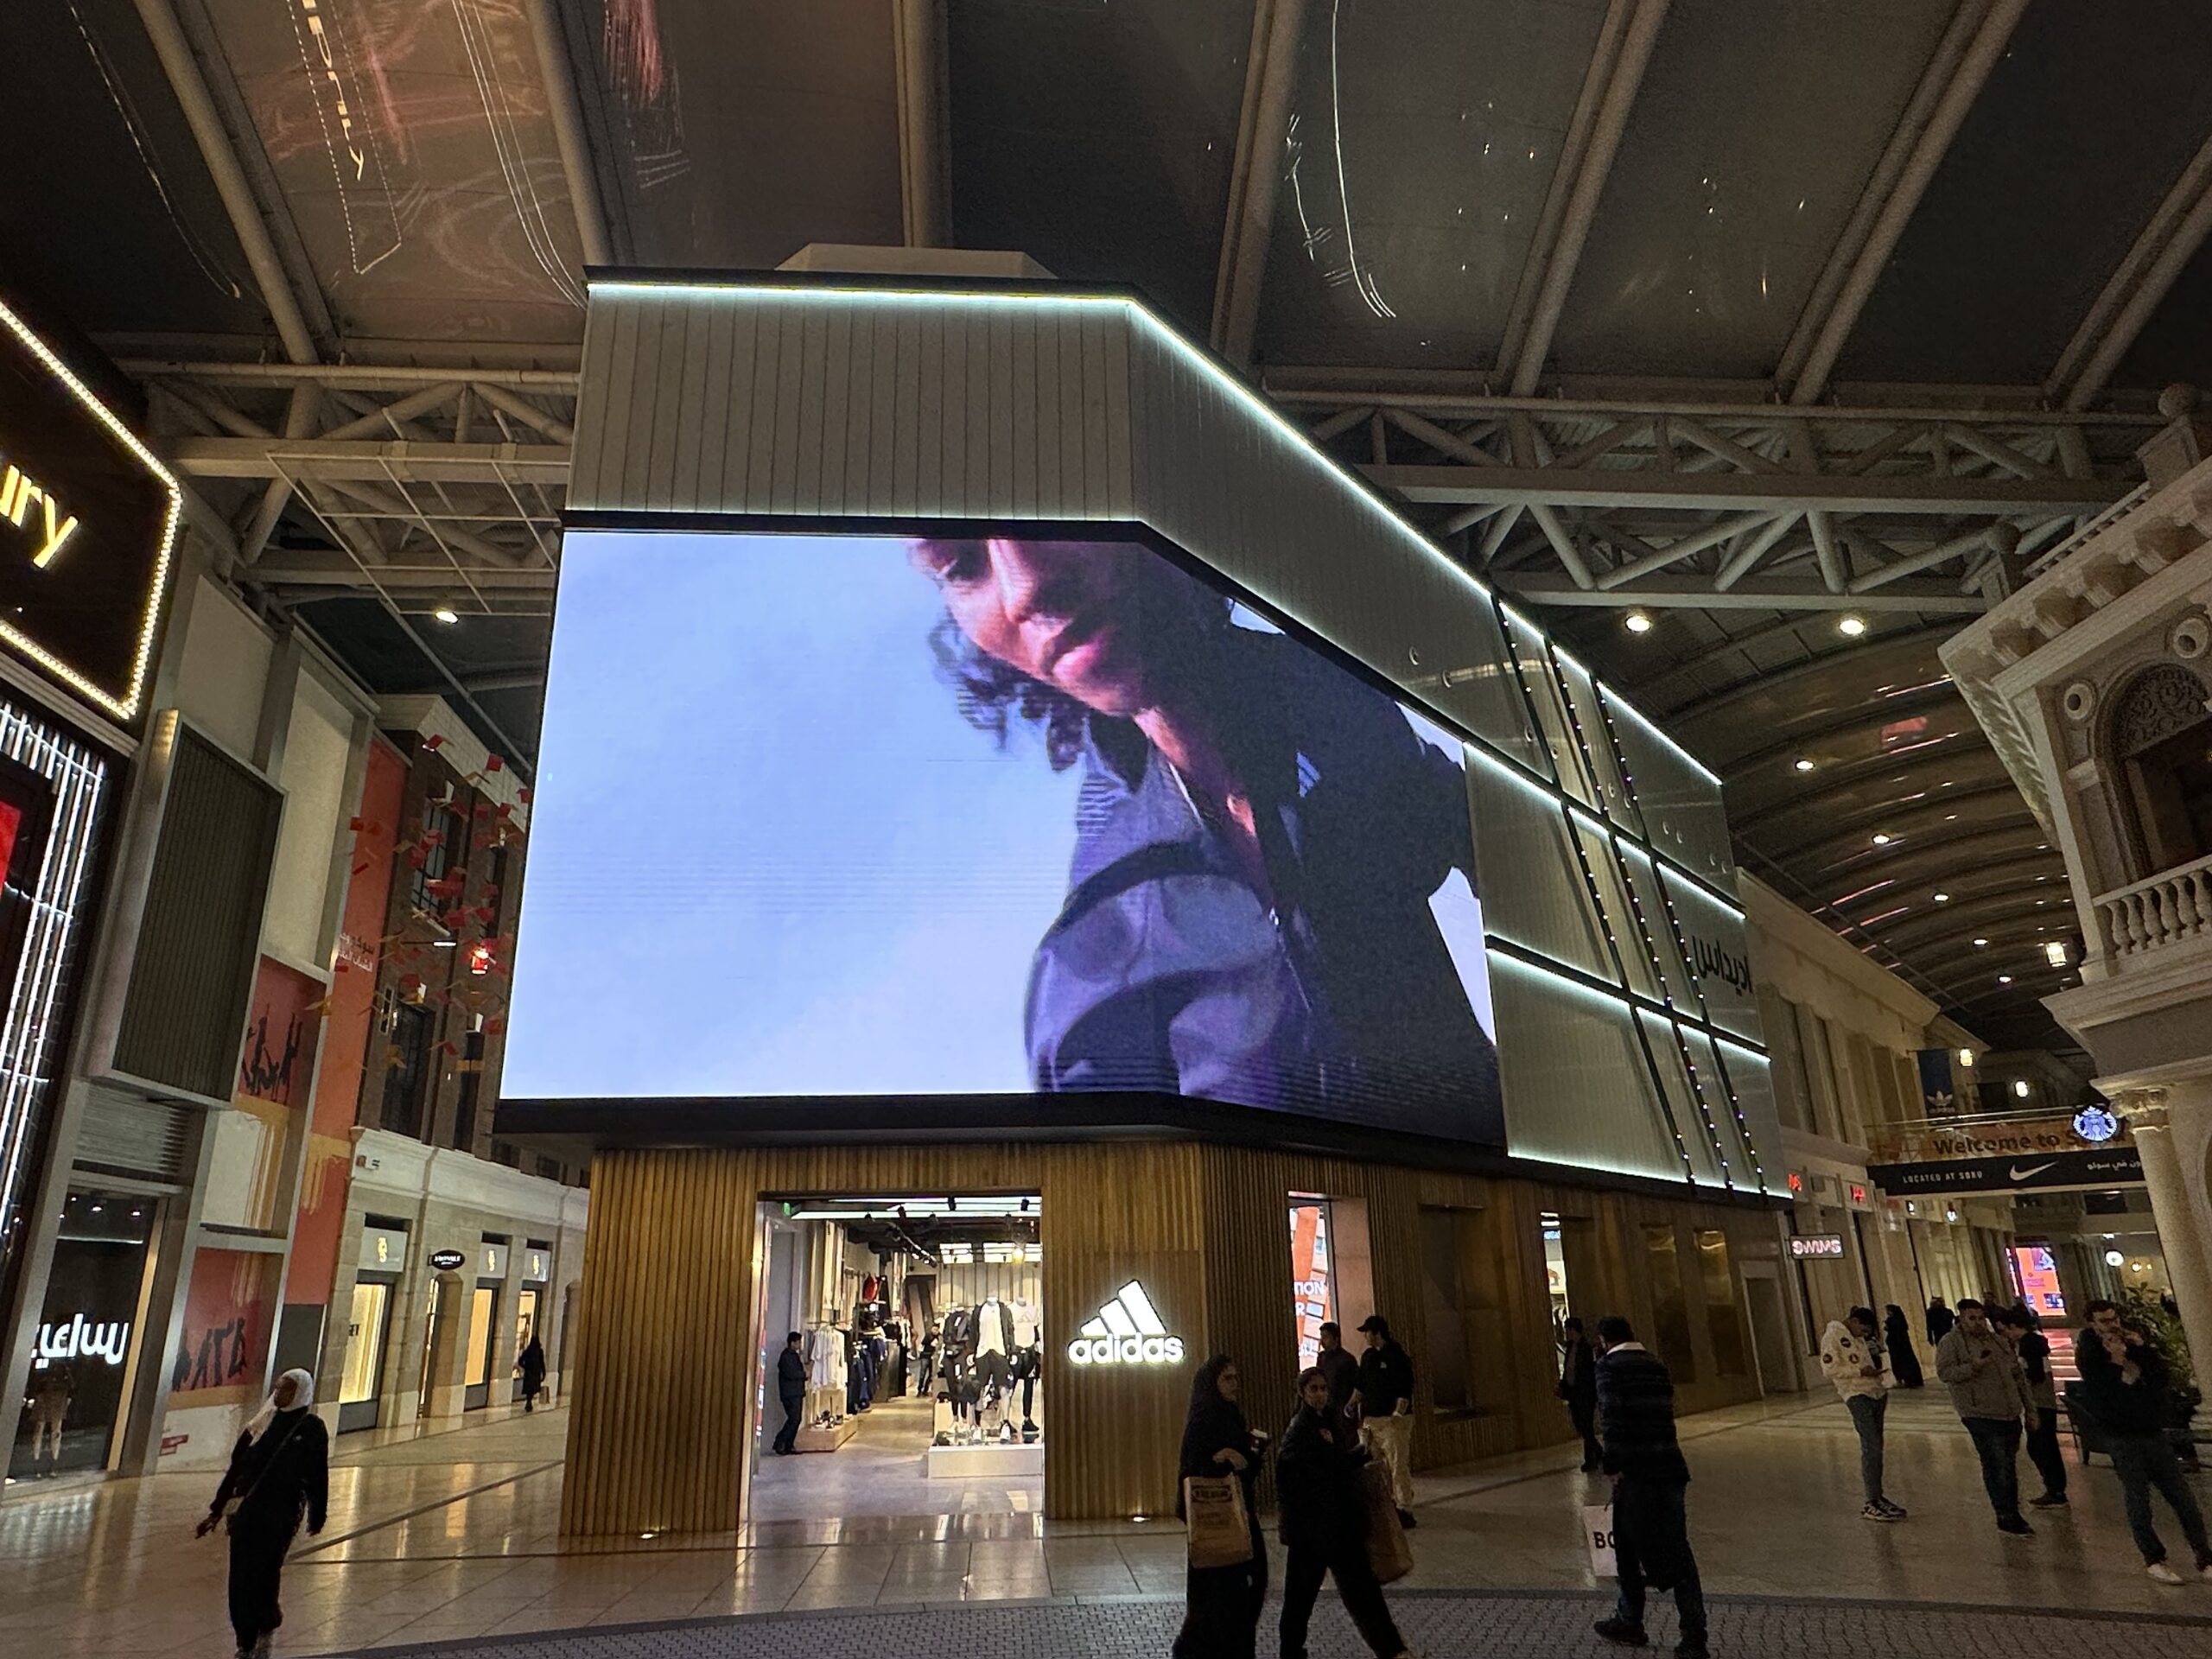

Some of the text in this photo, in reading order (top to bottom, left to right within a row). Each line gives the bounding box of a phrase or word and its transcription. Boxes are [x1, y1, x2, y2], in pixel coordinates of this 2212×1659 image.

[1934, 1135, 2031, 1154] Welcome
[2036, 1133, 2061, 1147] to
[1902, 1173, 1942, 1184] LOCATED
[1945, 1172, 1955, 1181] AT
[1067, 1333, 1185, 1364] adidas
